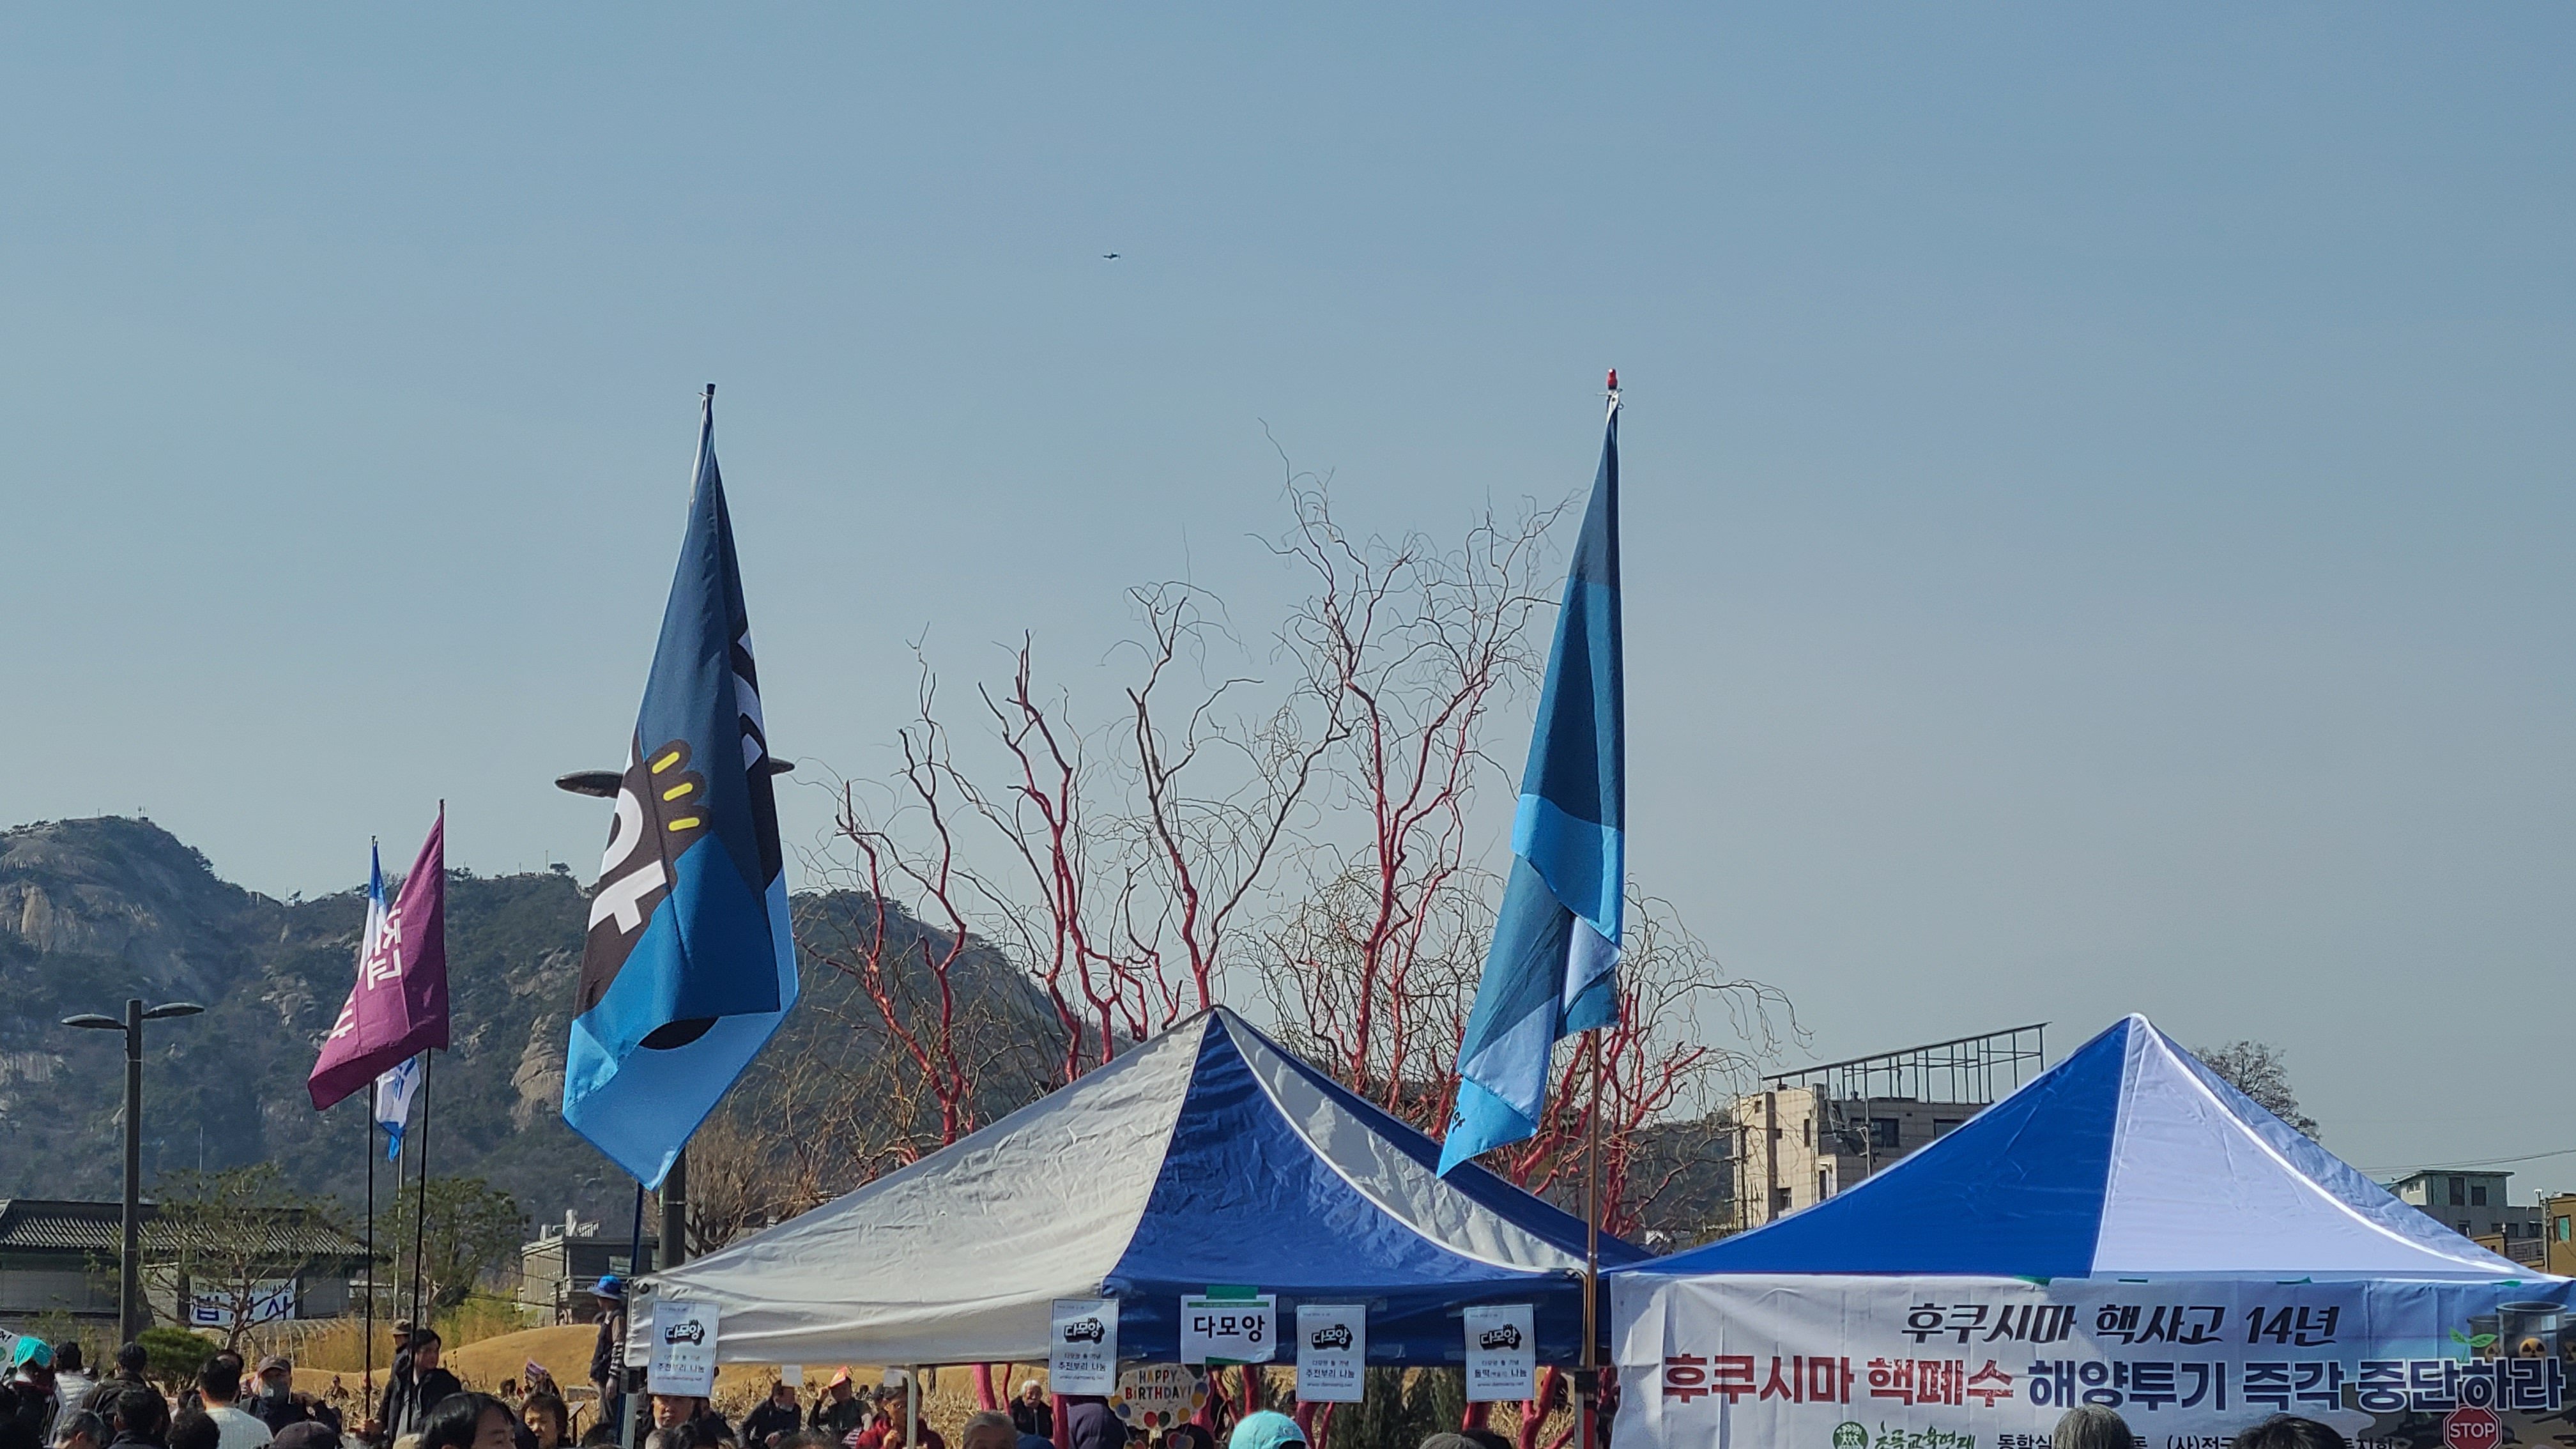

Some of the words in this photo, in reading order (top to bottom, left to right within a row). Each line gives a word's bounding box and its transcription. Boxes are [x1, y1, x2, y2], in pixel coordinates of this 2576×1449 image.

[665, 1322, 704, 1342] 다모앙
[1064, 1320, 1103, 1340] 다모앙
[1193, 1314, 1266, 1342] 다모앙
[1901, 1303, 2077, 1344] 후쿠시마
[2096, 1303, 2225, 1346] 핵사고
[2246, 1306, 2340, 1347] 14년
[1312, 1328, 1351, 1346] 다모앙
[1480, 1328, 1519, 1346] 다모앙
[1139, 1369, 1177, 1384] HAPPY
[1662, 1353, 1855, 1404] 후쿠시마
[1866, 1357, 2014, 1407] 핵폐수
[2028, 1359, 2227, 1411] 해양투기
[2244, 1360, 2345, 1411] 즉각
[2358, 1357, 2566, 1411] 중단하라
[2450, 1422, 2496, 1438] STOP
